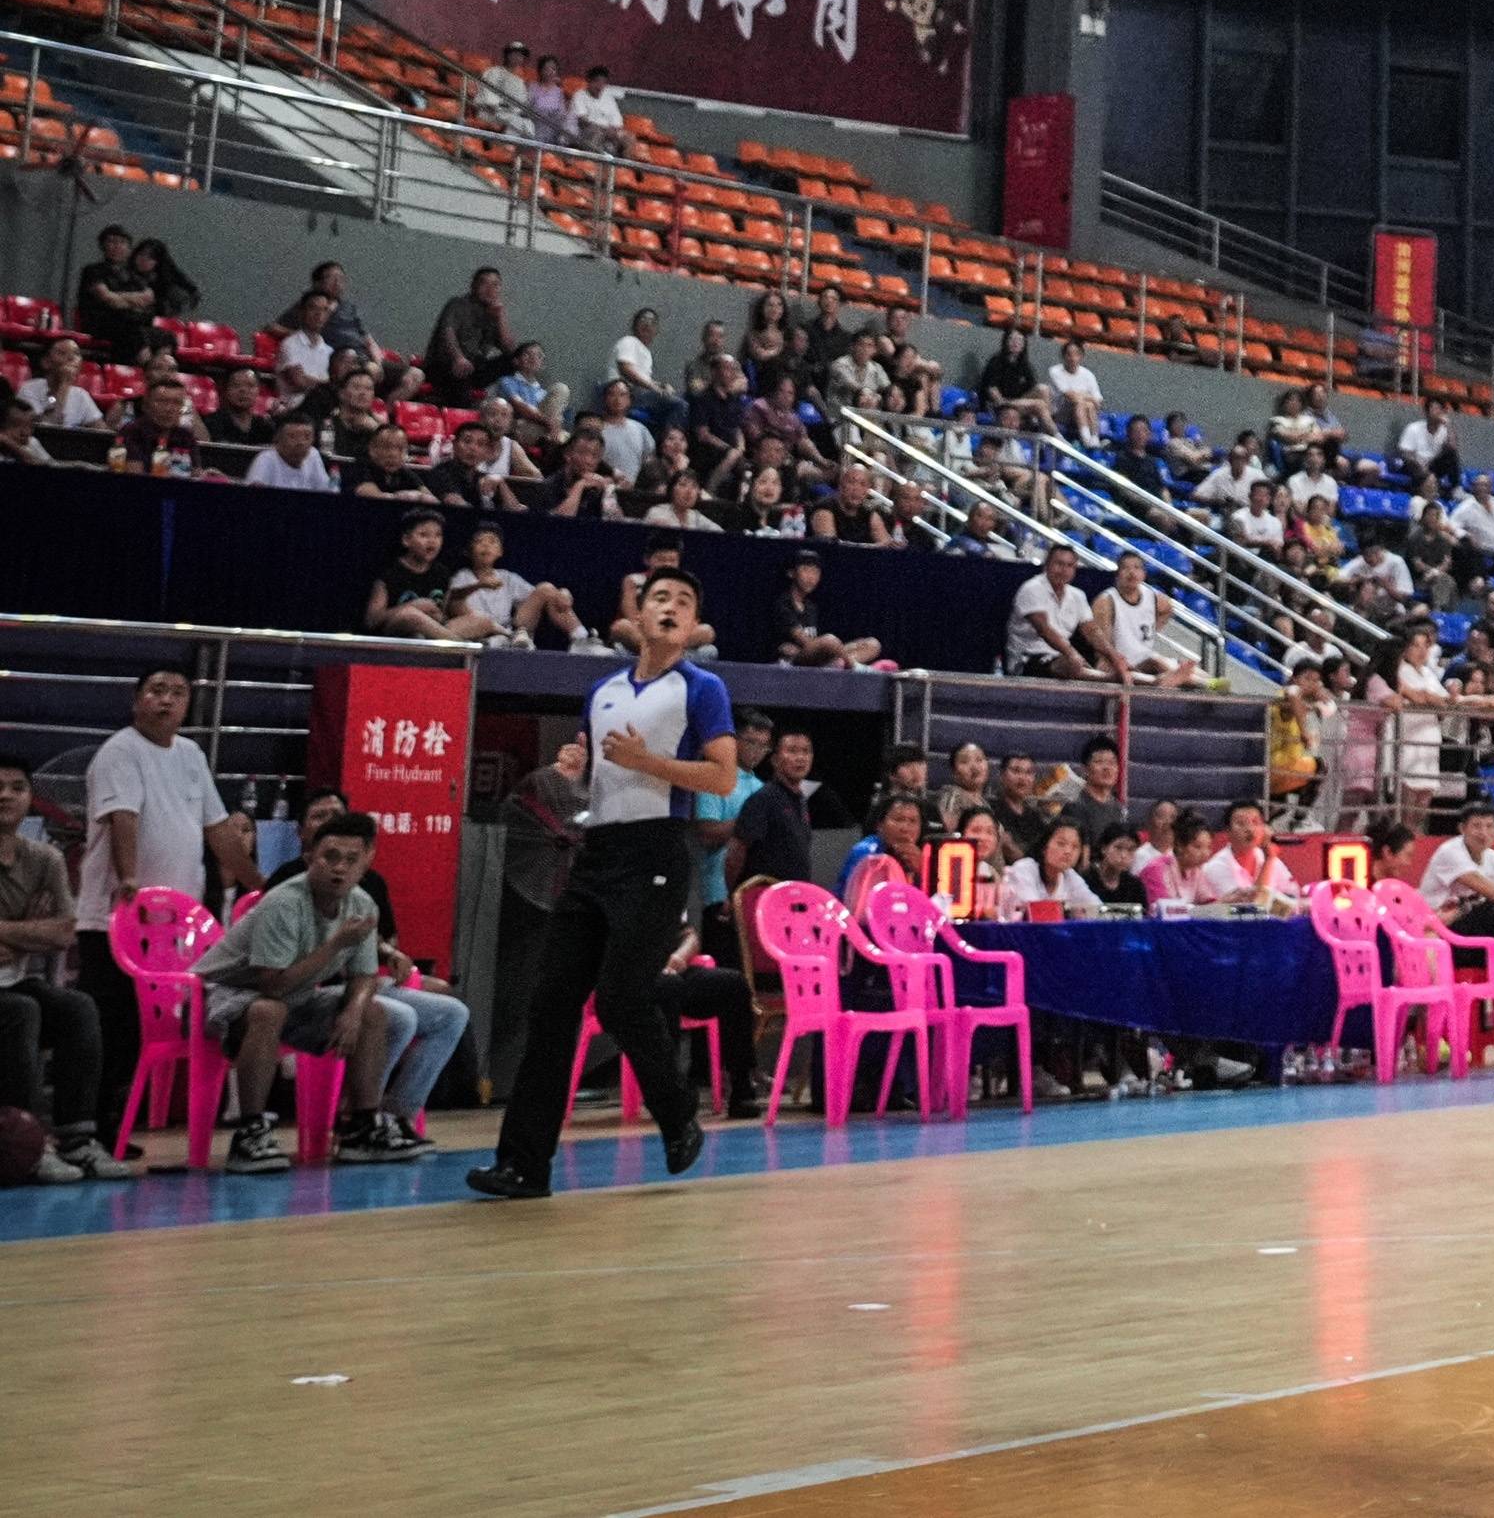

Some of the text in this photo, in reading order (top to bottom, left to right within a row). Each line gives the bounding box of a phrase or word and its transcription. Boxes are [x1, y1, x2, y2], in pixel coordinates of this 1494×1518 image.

[362, 716, 453, 759] 消防栓
[365, 762, 443, 785] Fire Hydrant
